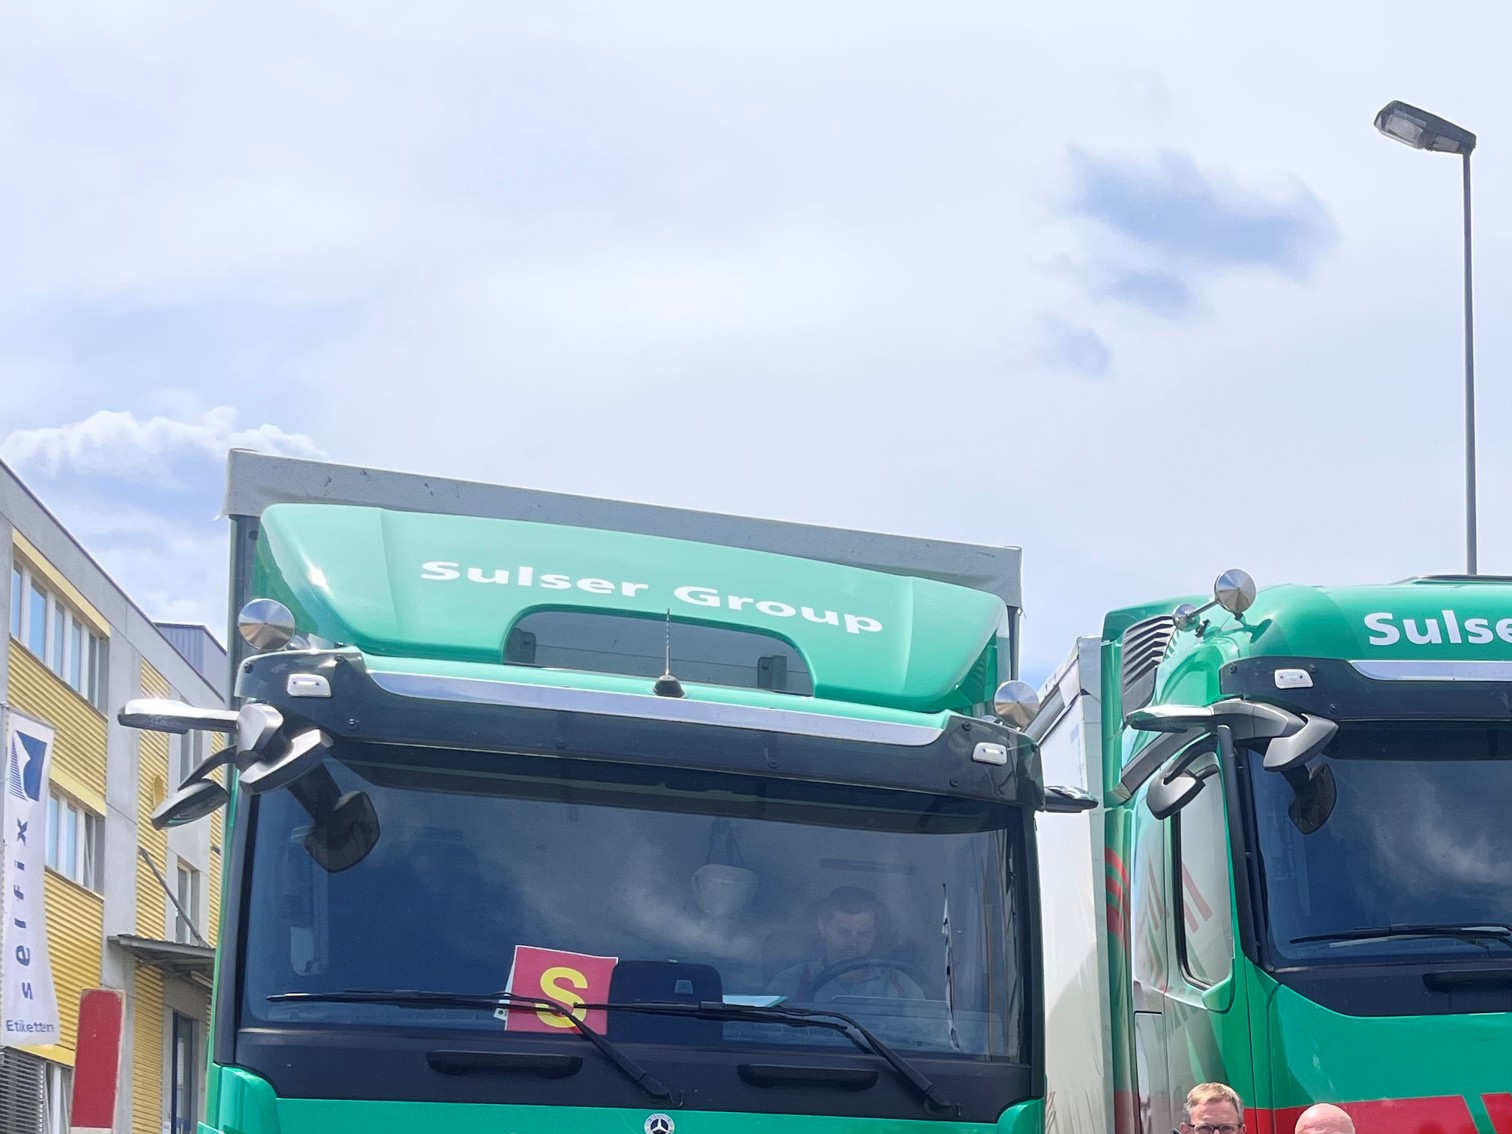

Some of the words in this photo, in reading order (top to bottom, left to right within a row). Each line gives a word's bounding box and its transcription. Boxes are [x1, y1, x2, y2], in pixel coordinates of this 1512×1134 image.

[421, 561, 649, 598] Sulser
[674, 585, 884, 635] Group
[6, 1019, 55, 1034] Etiketten
[535, 966, 589, 1028] S
